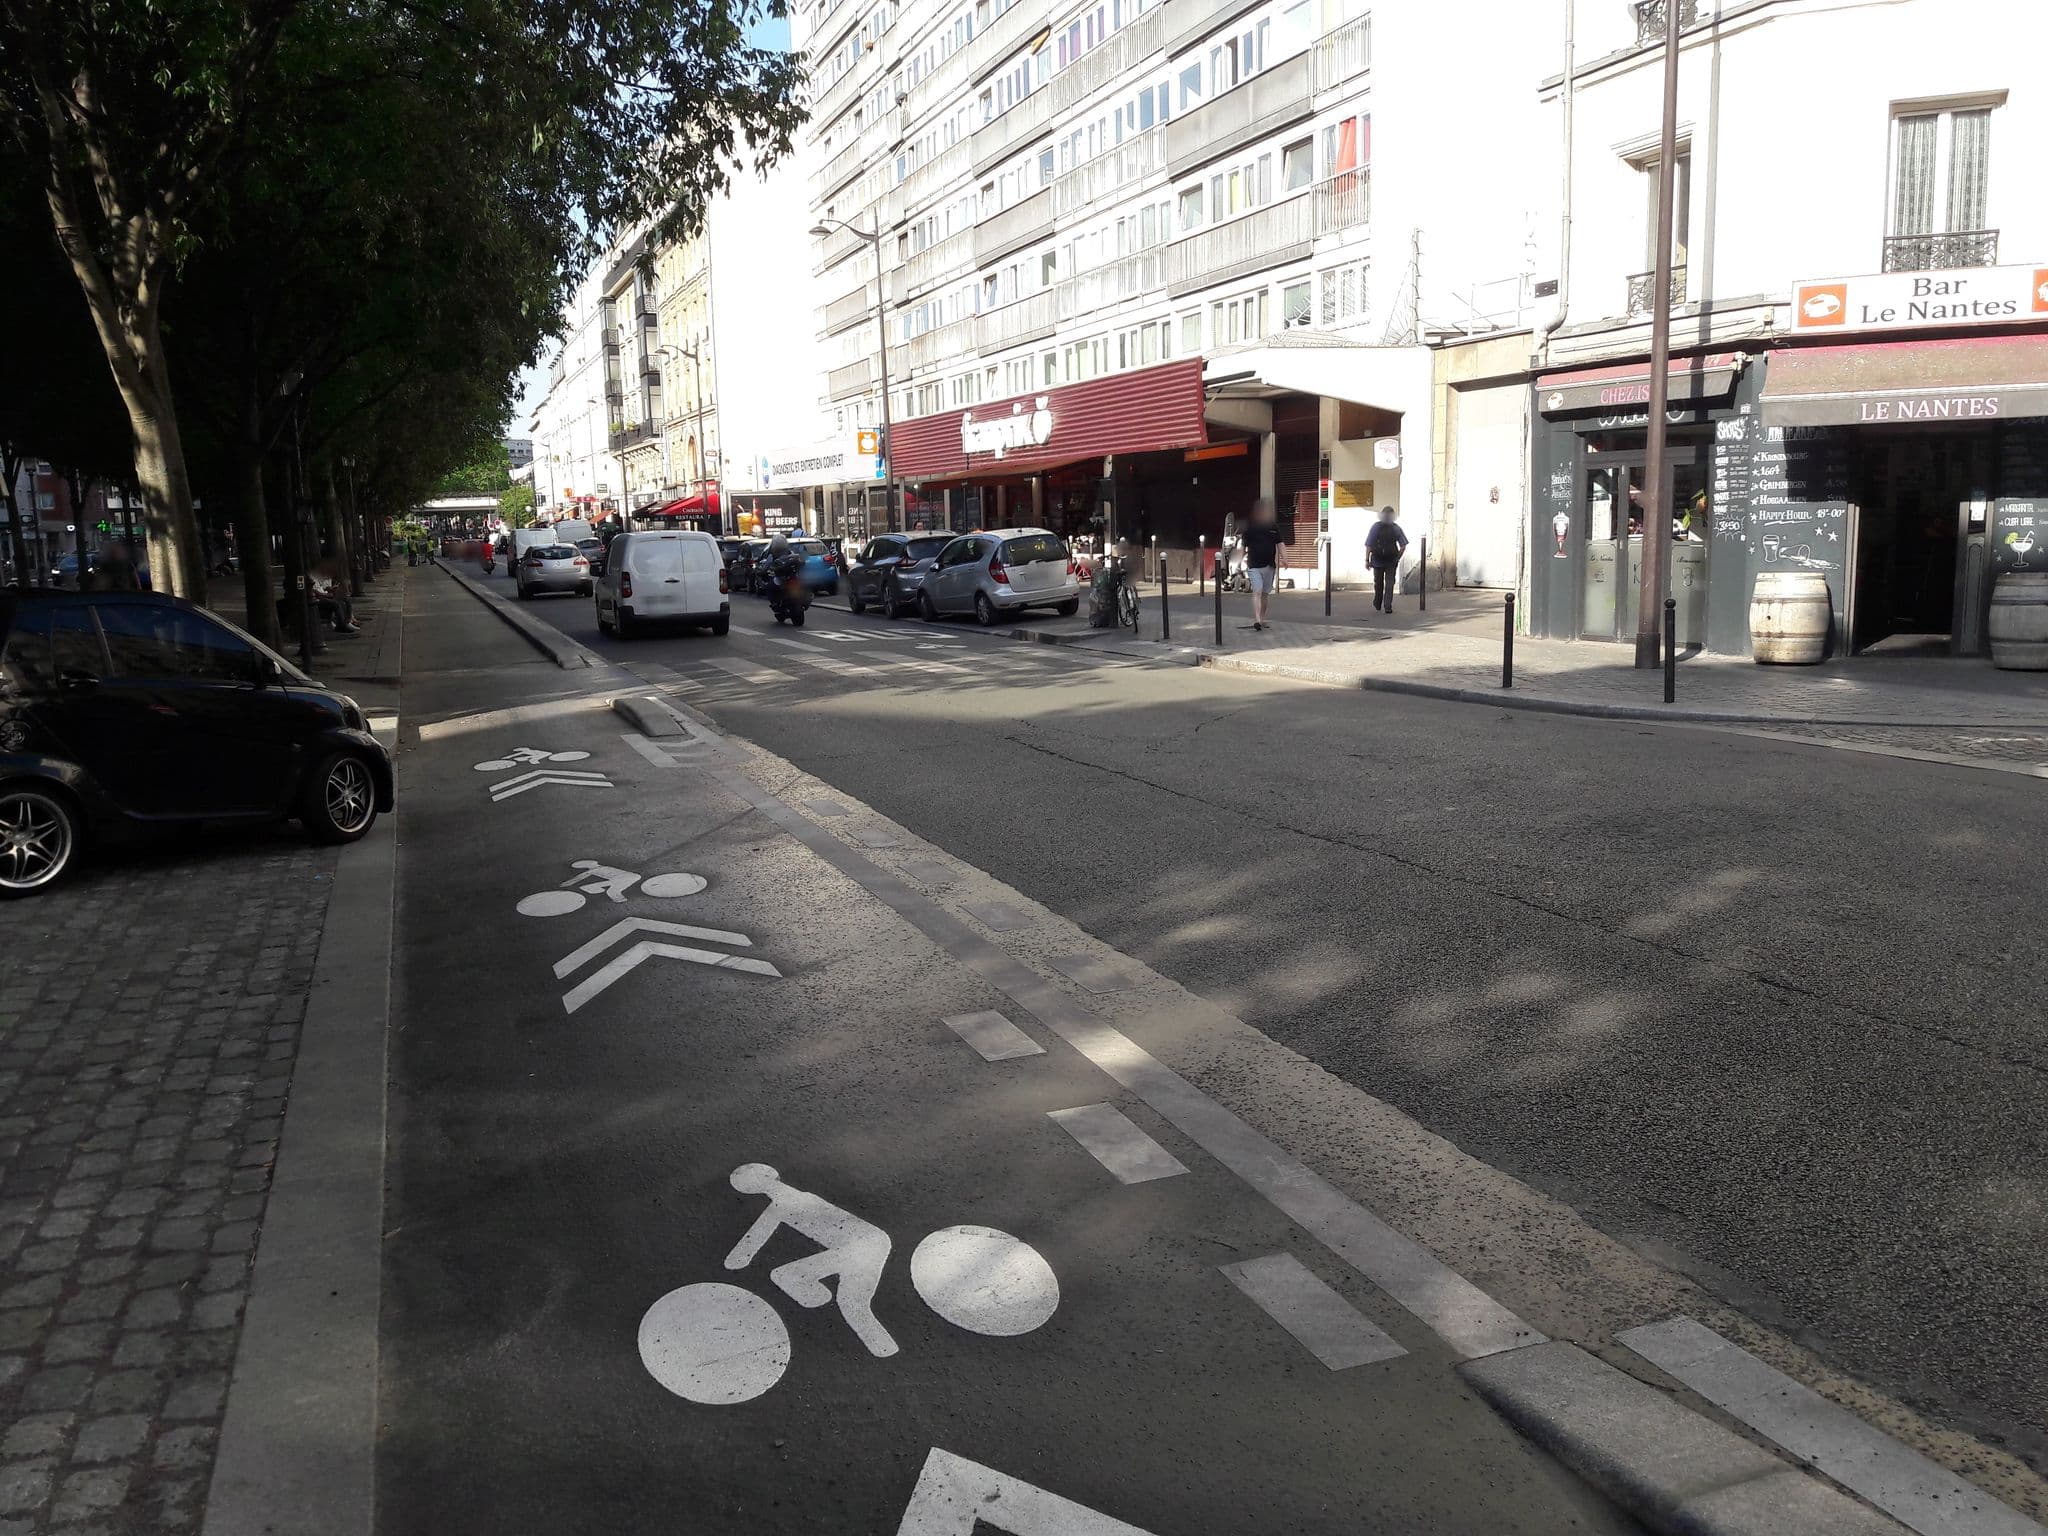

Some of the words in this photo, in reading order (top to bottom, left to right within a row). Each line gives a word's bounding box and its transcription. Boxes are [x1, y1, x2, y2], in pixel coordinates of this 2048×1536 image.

[1913, 277, 1967, 297] Bar
[1861, 304, 1896, 324] Le
[1908, 299, 2017, 321] Nantes
[1861, 402, 1891, 421] LE
[1897, 398, 1999, 418] NANTES
[764, 508, 783, 517] KING
[765, 518, 774, 526] OF
[775, 517, 798, 525] BEERS
